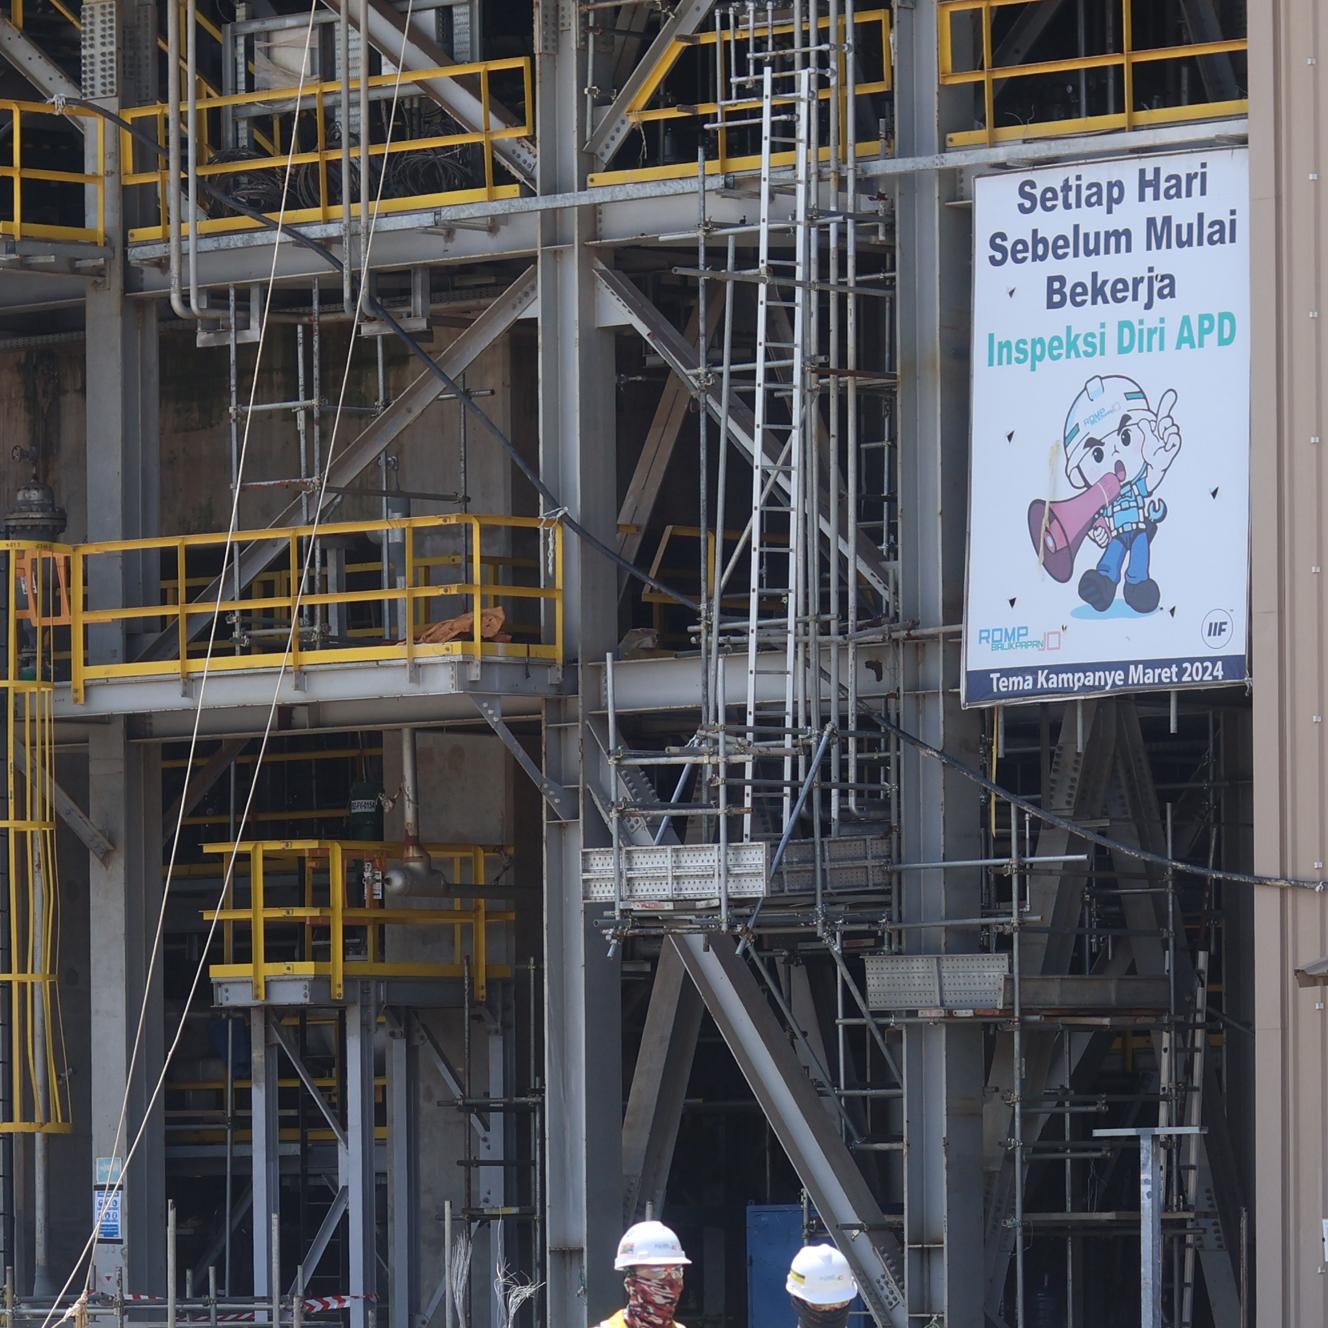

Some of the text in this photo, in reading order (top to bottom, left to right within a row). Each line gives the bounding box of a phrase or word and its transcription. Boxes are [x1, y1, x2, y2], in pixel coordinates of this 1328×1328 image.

[1017, 162, 1208, 215] Setiap Hari
[988, 208, 1237, 267] Sebelum Mulai
[1046, 266, 1176, 311] Bekerja
[987, 311, 1236, 372] Inspeksi Diri APD
[990, 660, 1223, 692] Tema Kampanye Maret 2024
